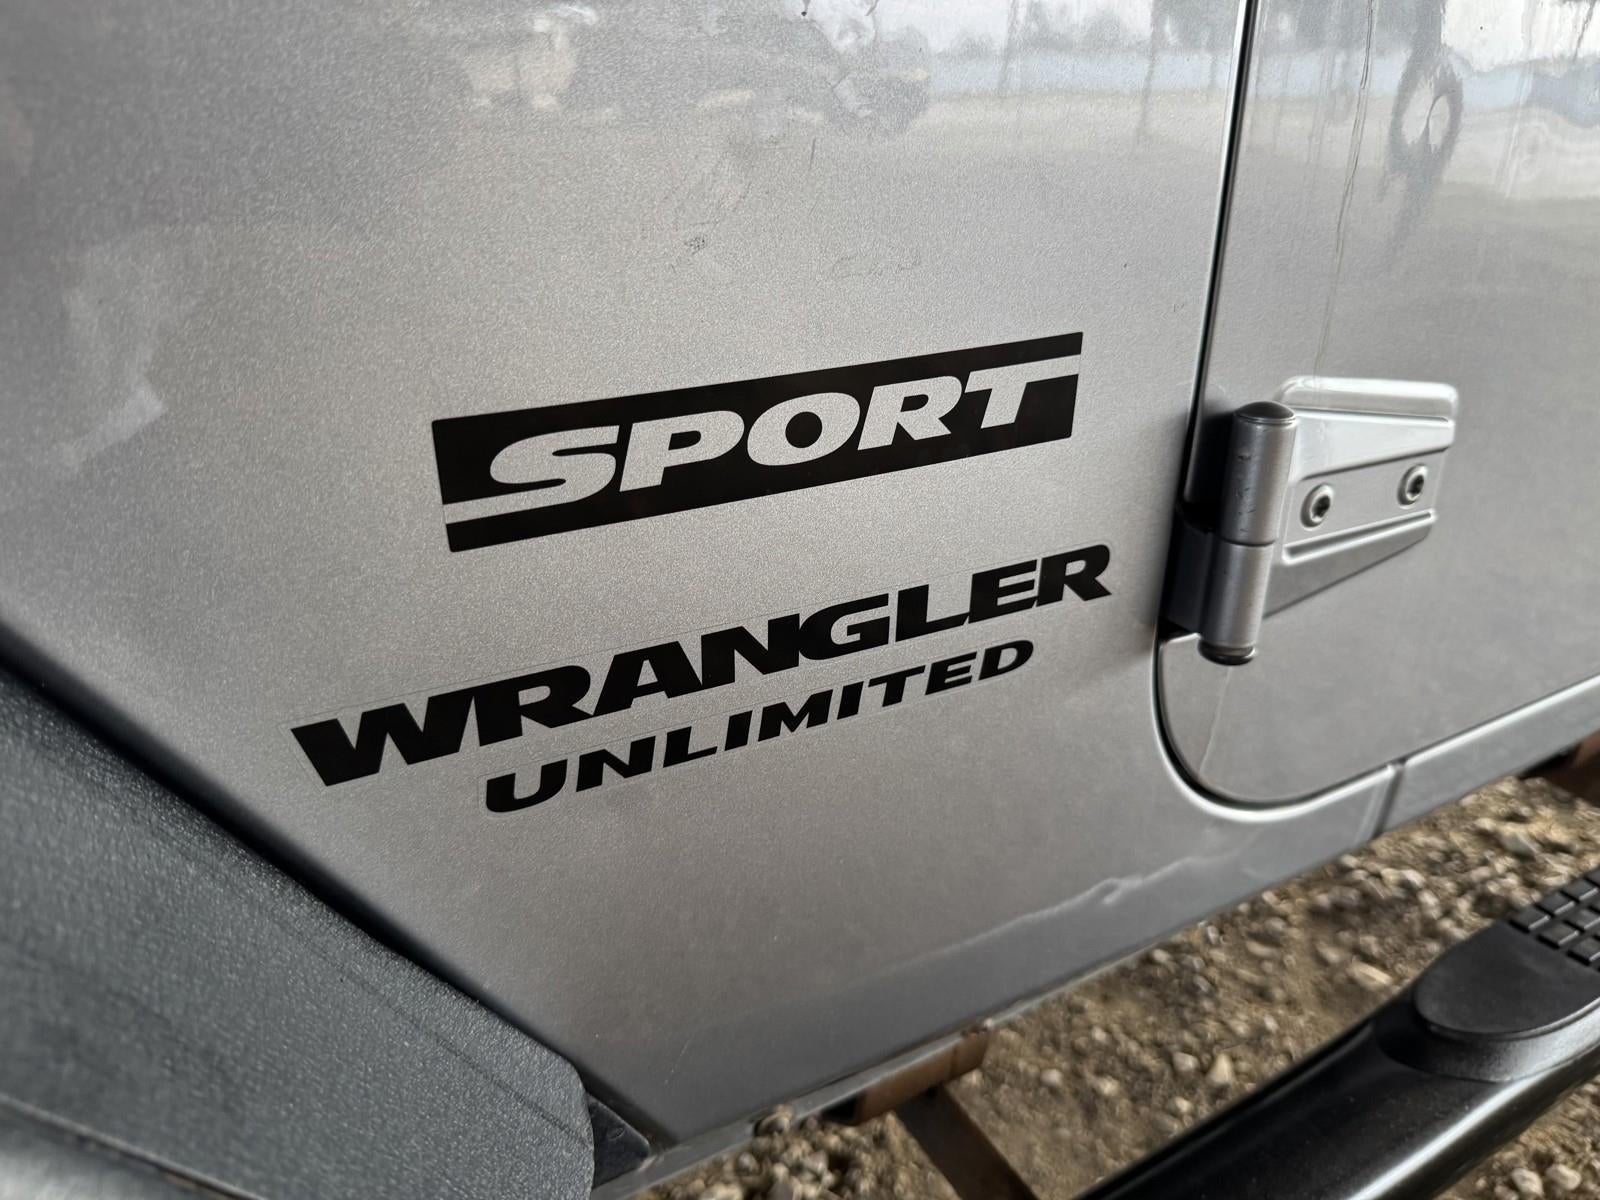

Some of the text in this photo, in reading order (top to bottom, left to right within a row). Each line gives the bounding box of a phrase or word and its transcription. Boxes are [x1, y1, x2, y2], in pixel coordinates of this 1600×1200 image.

[489, 357, 1066, 507] SPORT
[291, 544, 1112, 787] WRANGLER
[485, 639, 1034, 813] UNLIMITED
